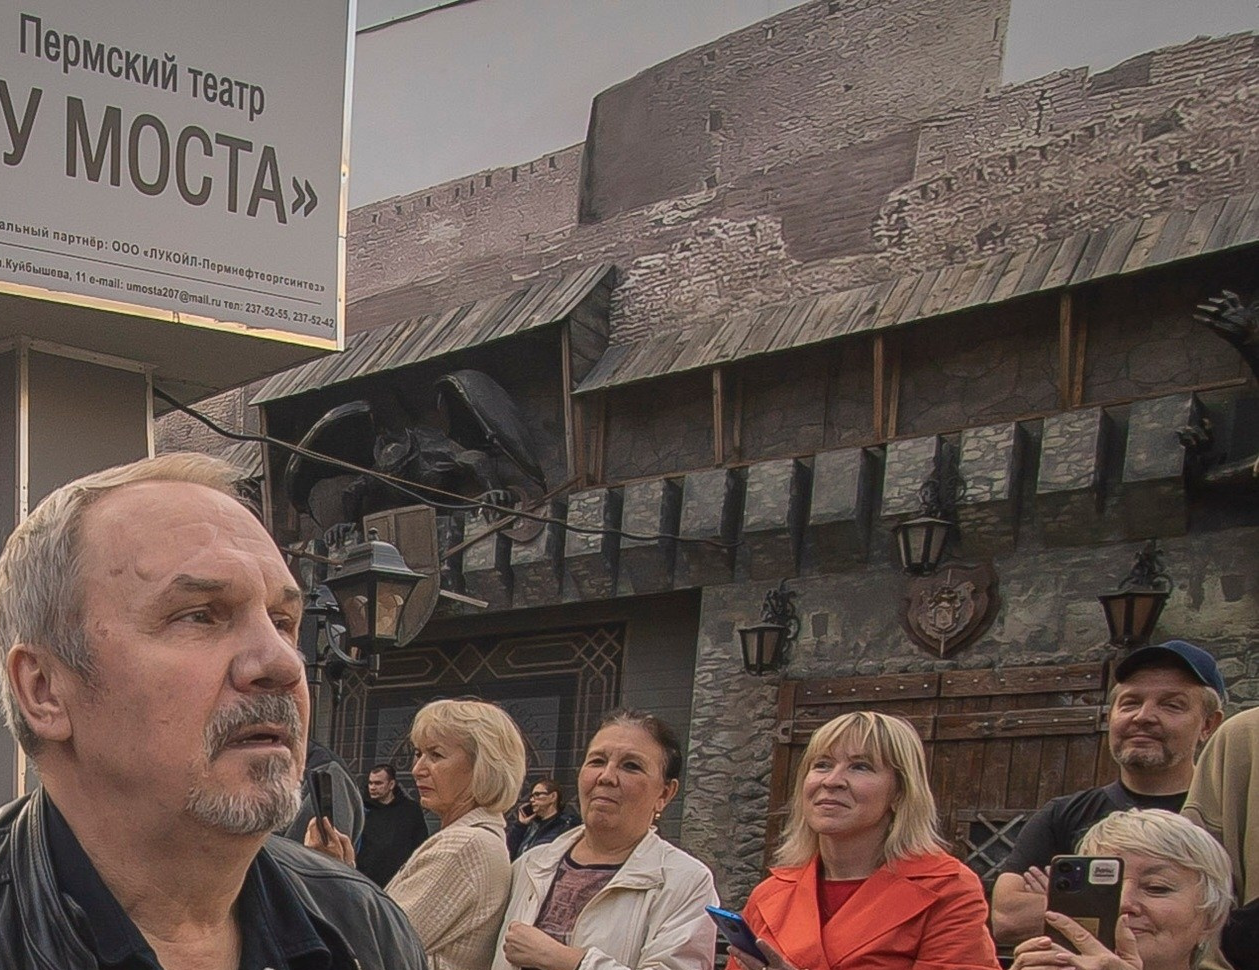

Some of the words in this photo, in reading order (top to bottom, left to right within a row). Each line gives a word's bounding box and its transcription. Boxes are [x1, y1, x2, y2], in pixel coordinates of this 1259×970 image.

[20, 13, 178, 92] Пермский
[188, 66, 266, 122] театр
[66, 96, 318, 225] МОСТА»
[53, 230, 109, 251] партнёр:
[112, 240, 140, 256] ООО
[143, 248, 325, 293] «ЛУКОЙЛ-Пермнефтеоргсинтез»
[75, 271, 86, 283] 11
[89, 274, 124, 290] e-mail:
[126, 281, 222, 307] umosta207@mail.ru
[224, 300, 242, 312] тел:
[245, 302, 291, 322] 237-52-55,
[293, 311, 334, 329] 237-52-42
